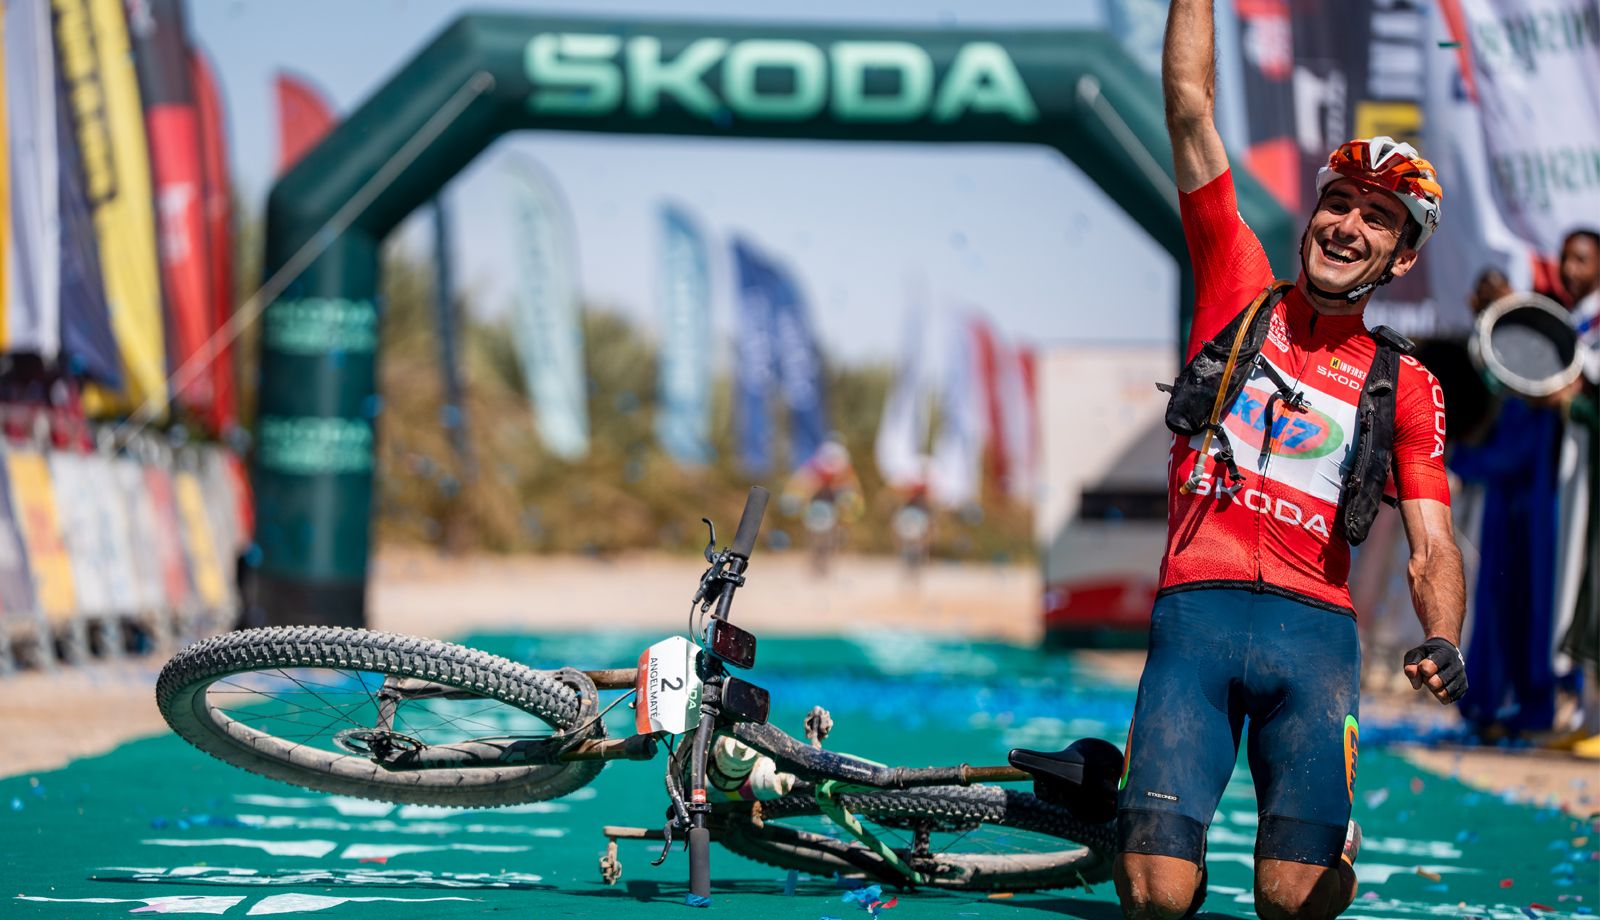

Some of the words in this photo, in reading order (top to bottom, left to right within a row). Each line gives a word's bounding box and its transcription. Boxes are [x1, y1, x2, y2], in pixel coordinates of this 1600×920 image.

[1189, 470, 1330, 538] SKODA
[650, 657, 659, 690] ANGEL
[661, 677, 684, 692] 2
